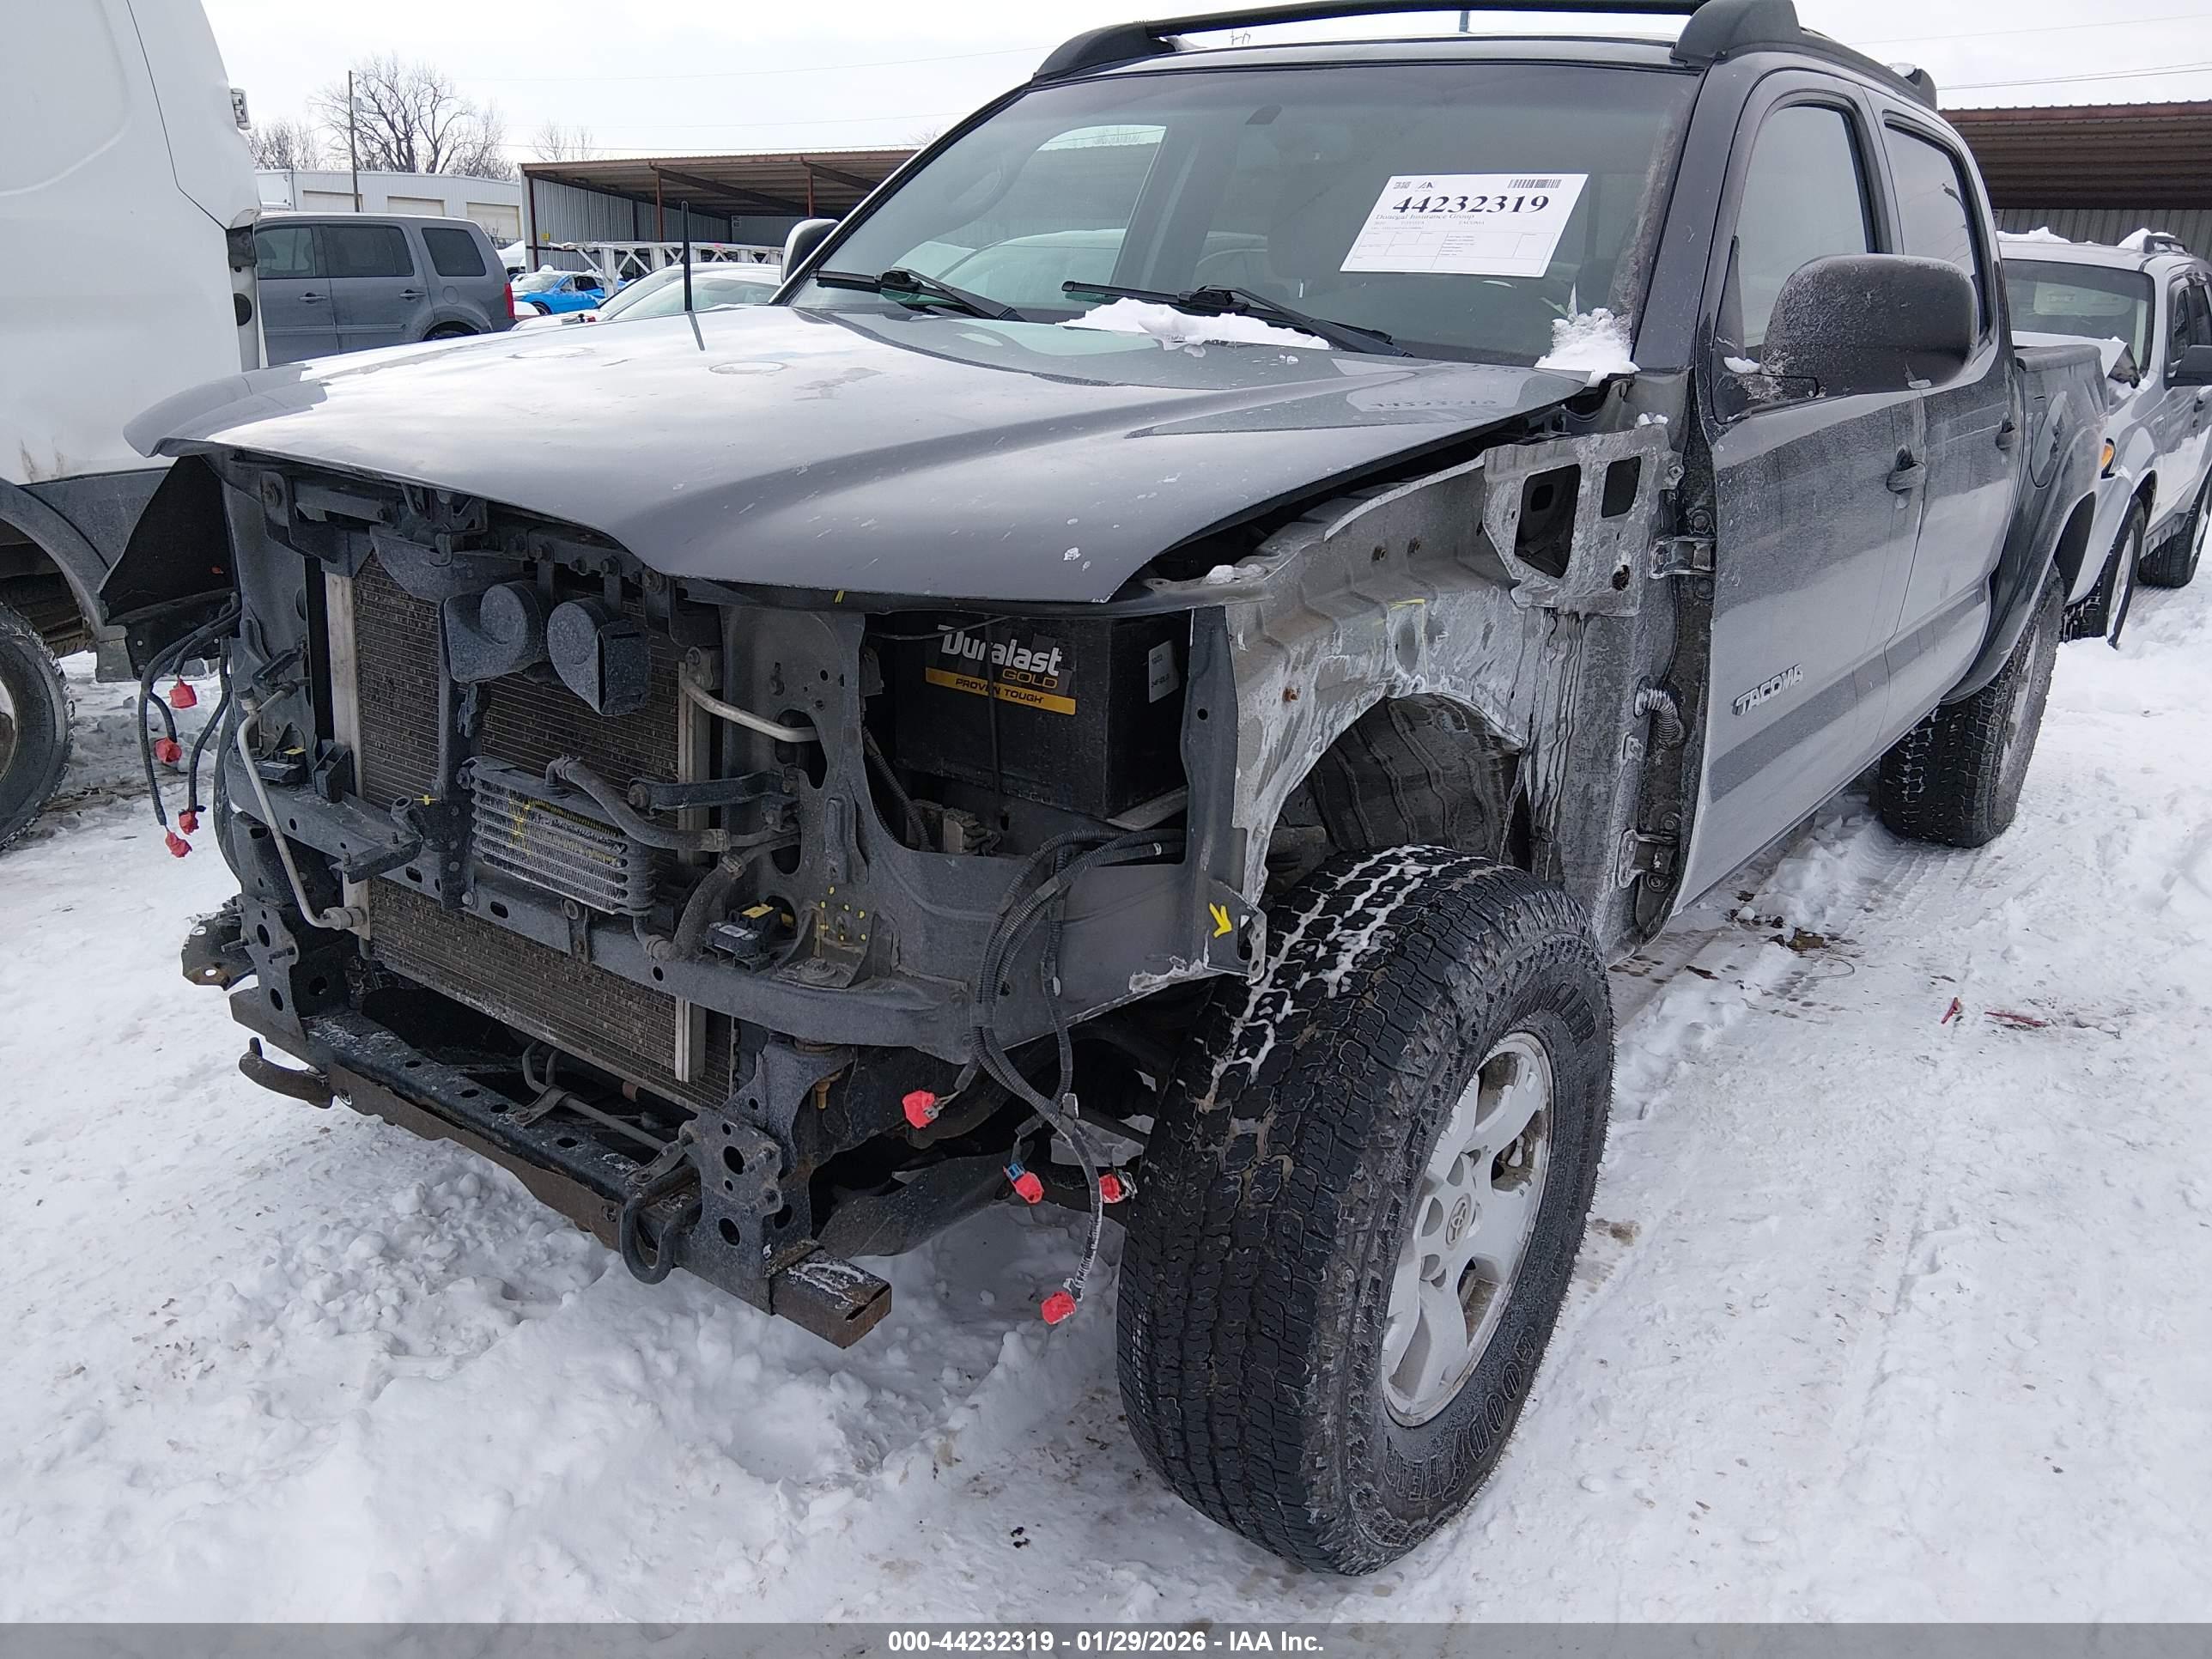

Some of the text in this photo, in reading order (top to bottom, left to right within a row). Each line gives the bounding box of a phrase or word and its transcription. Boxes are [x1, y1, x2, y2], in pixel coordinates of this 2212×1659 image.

[1392, 195, 1549, 214] 44232319
[938, 624, 1063, 677] Duralast
[1002, 668, 1058, 690] GOLD
[1732, 663, 1803, 716] TACOMA
[1005, 688, 1044, 704] TOUGH
